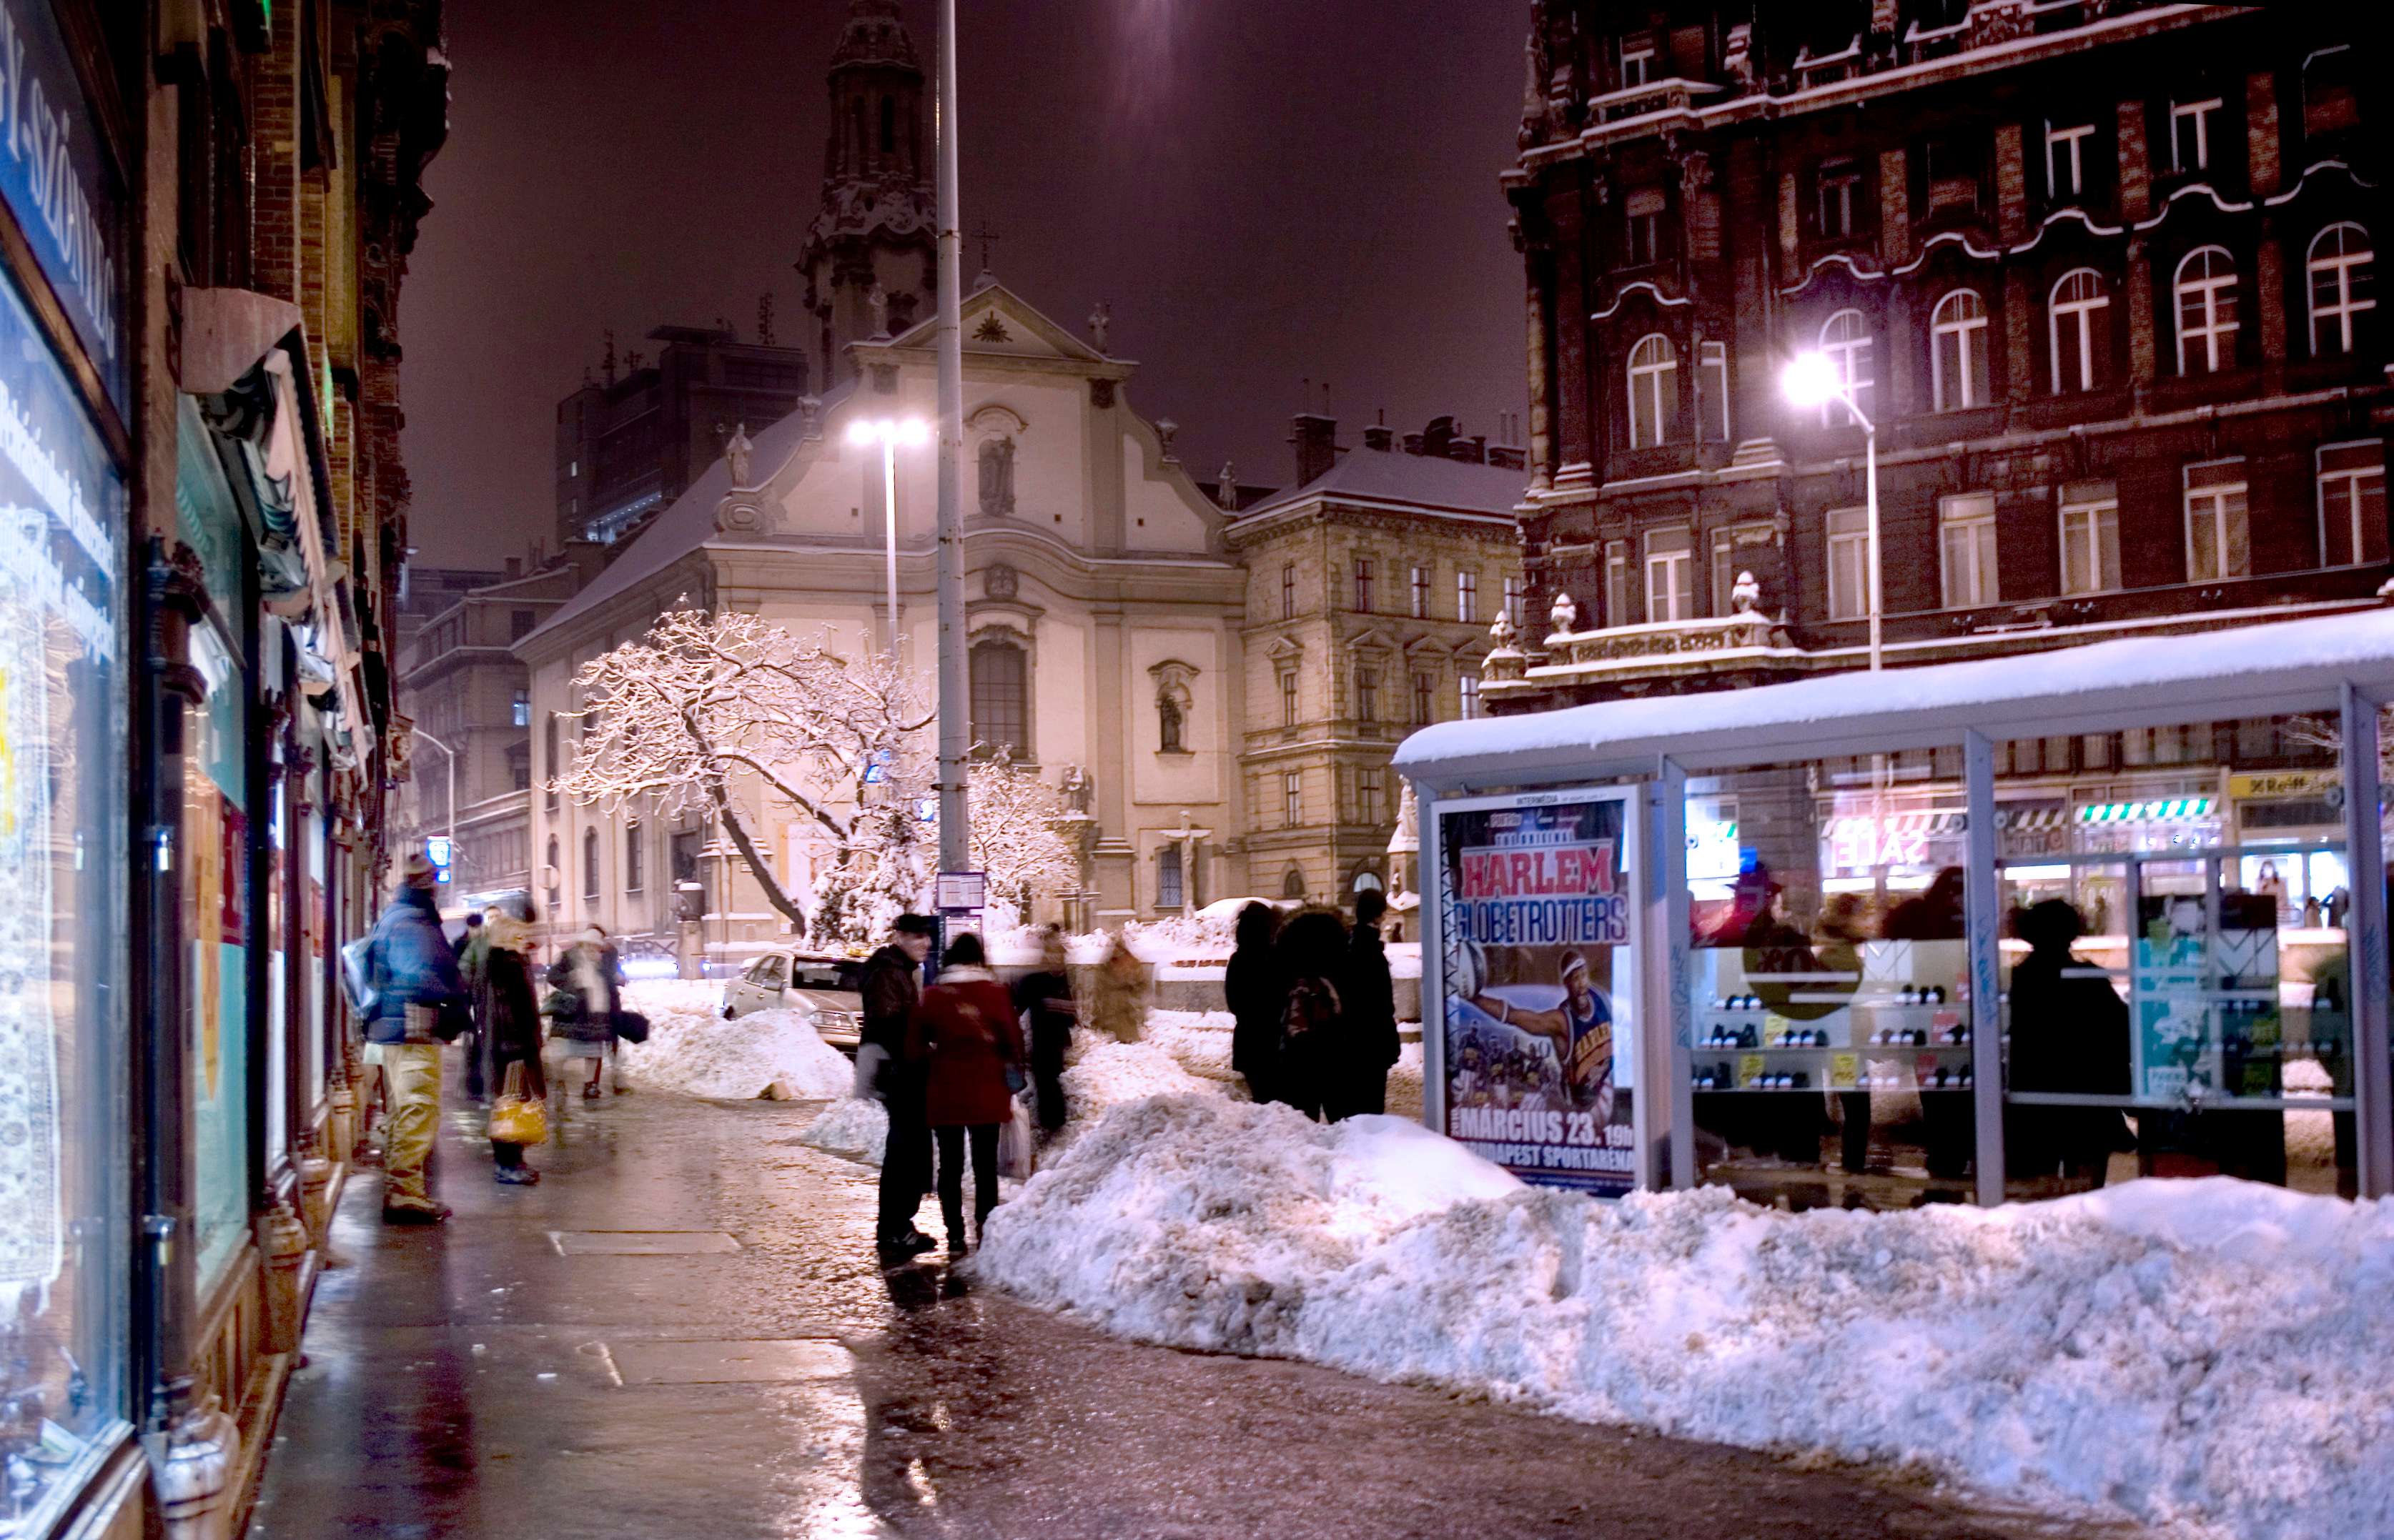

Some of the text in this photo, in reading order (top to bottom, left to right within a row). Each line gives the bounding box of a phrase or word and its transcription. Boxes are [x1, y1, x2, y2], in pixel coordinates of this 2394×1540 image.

[1462, 847, 1613, 899] HARLEM
[1454, 896, 1627, 943] GLOBETROTTERS
[1460, 1103, 1563, 1142] MÁRCIUS
[1566, 1111, 1601, 1145] 23.
[1543, 1145, 1636, 1171] SPORTARÉNA
